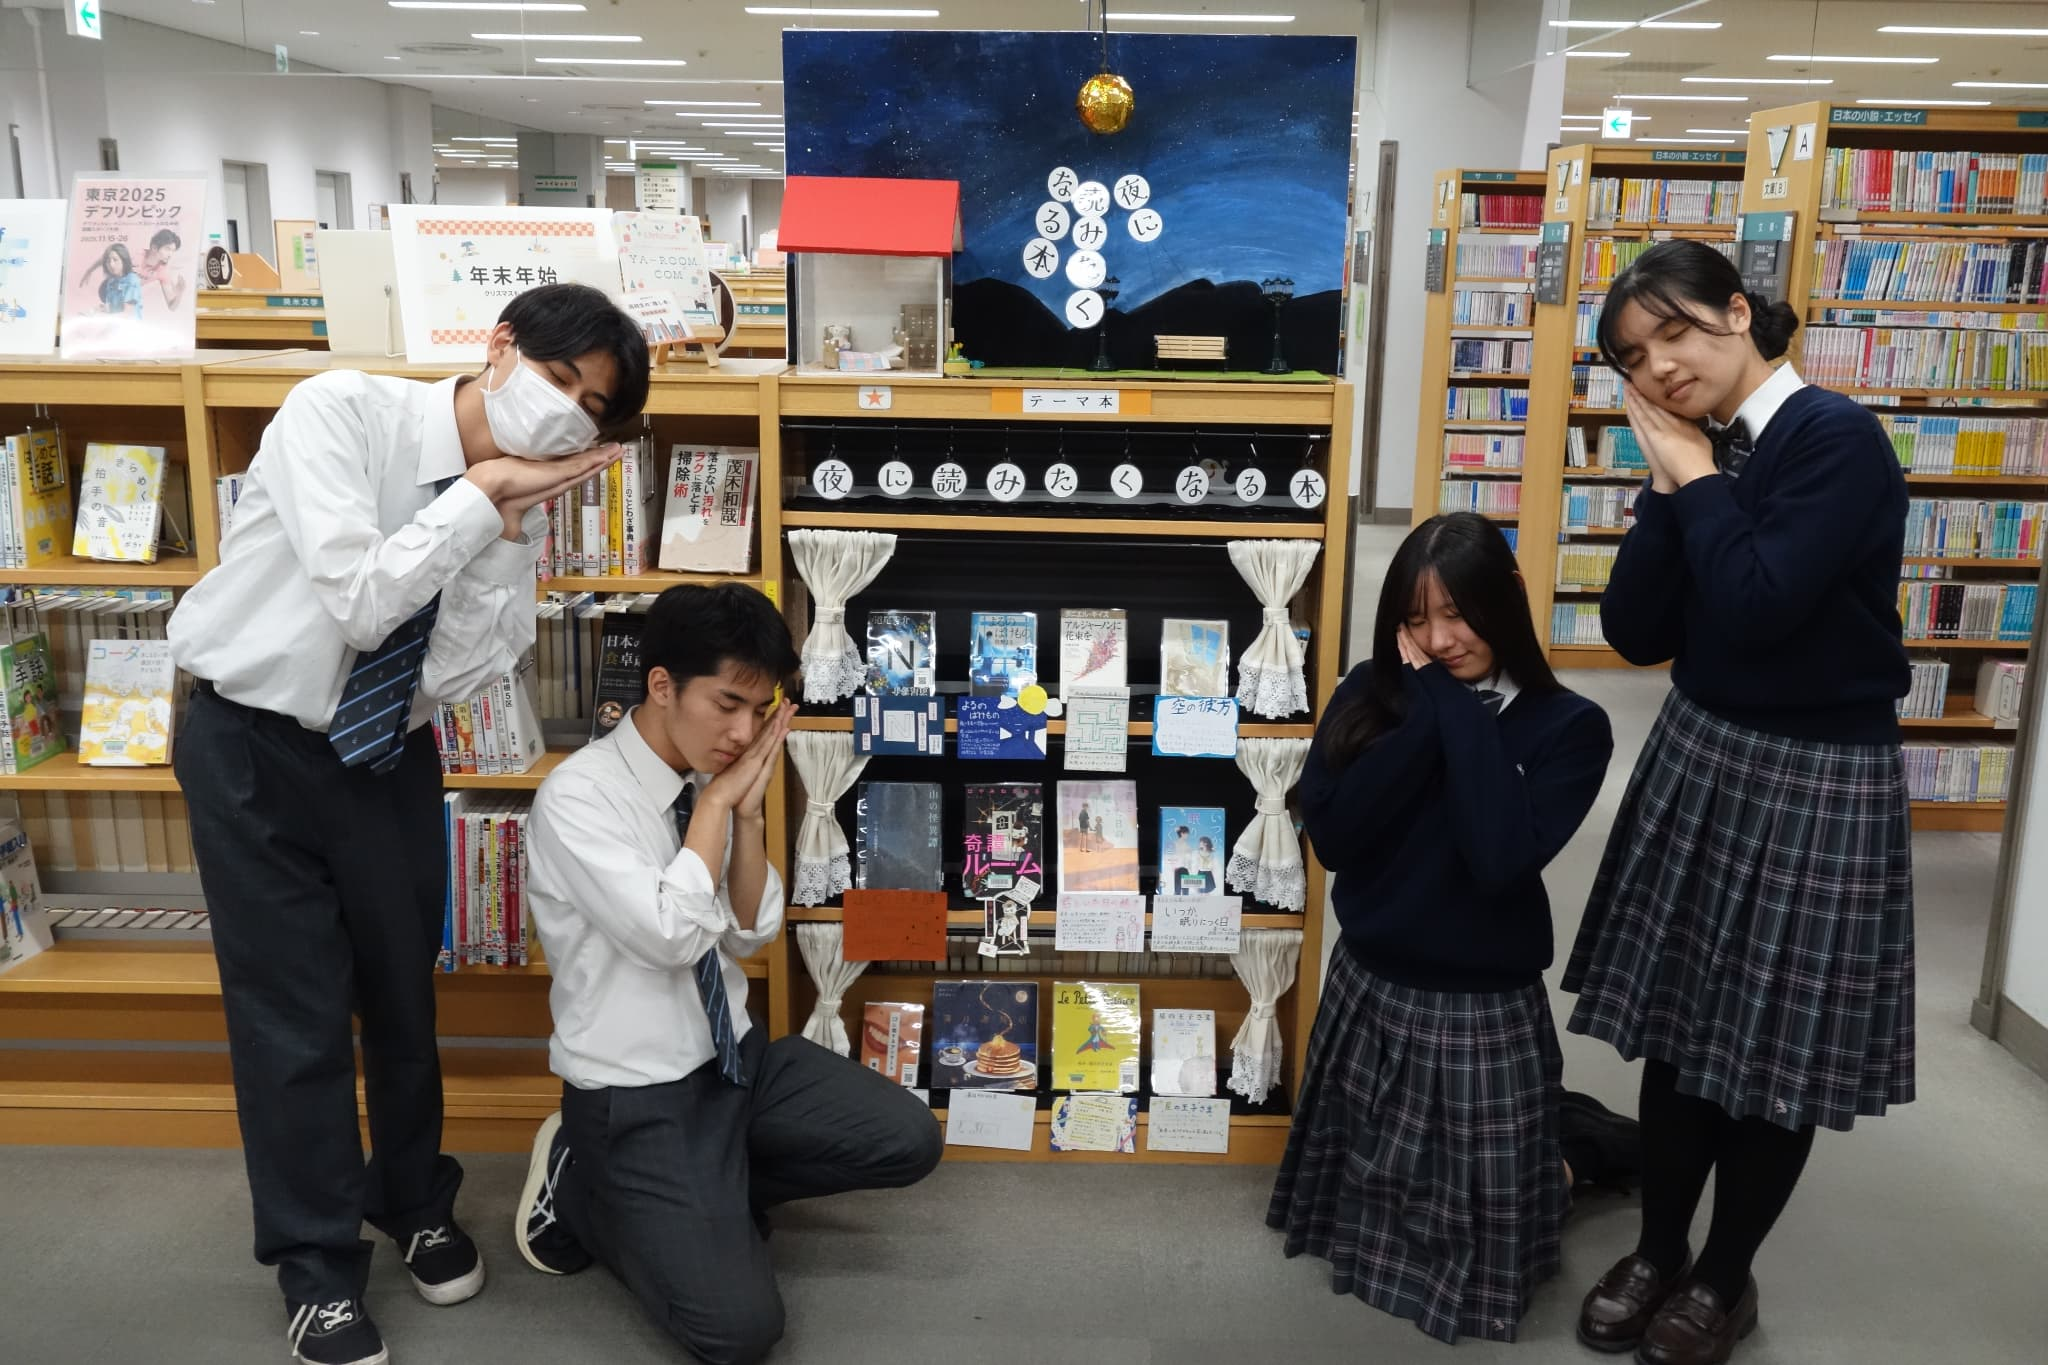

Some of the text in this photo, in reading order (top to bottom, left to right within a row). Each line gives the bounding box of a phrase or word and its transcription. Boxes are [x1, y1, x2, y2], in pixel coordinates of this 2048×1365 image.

[1833, 109, 1921, 123] 日本の小説・エッセイ
[1800, 134, 1808, 152] A
[1655, 151, 1719, 161] 日本の小説・エッセイ
[86, 188, 166, 202] 東京2025
[85, 205, 181, 219] デフリンピック
[470, 265, 558, 285] 年末年始
[1030, 395, 1113, 408] テーマ本
[674, 451, 692, 498] 掃除術
[689, 452, 705, 515] ラクに落とす
[701, 452, 719, 526] 落ちない汚れを
[721, 459, 744, 525] 茂木和哉
[1064, 621, 1122, 631] アルジャーノンに
[1066, 631, 1092, 641] 花束を
[961, 701, 987, 711] よるの
[1167, 699, 1231, 716] 空の彼方
[963, 853, 1042, 876] ルーム
